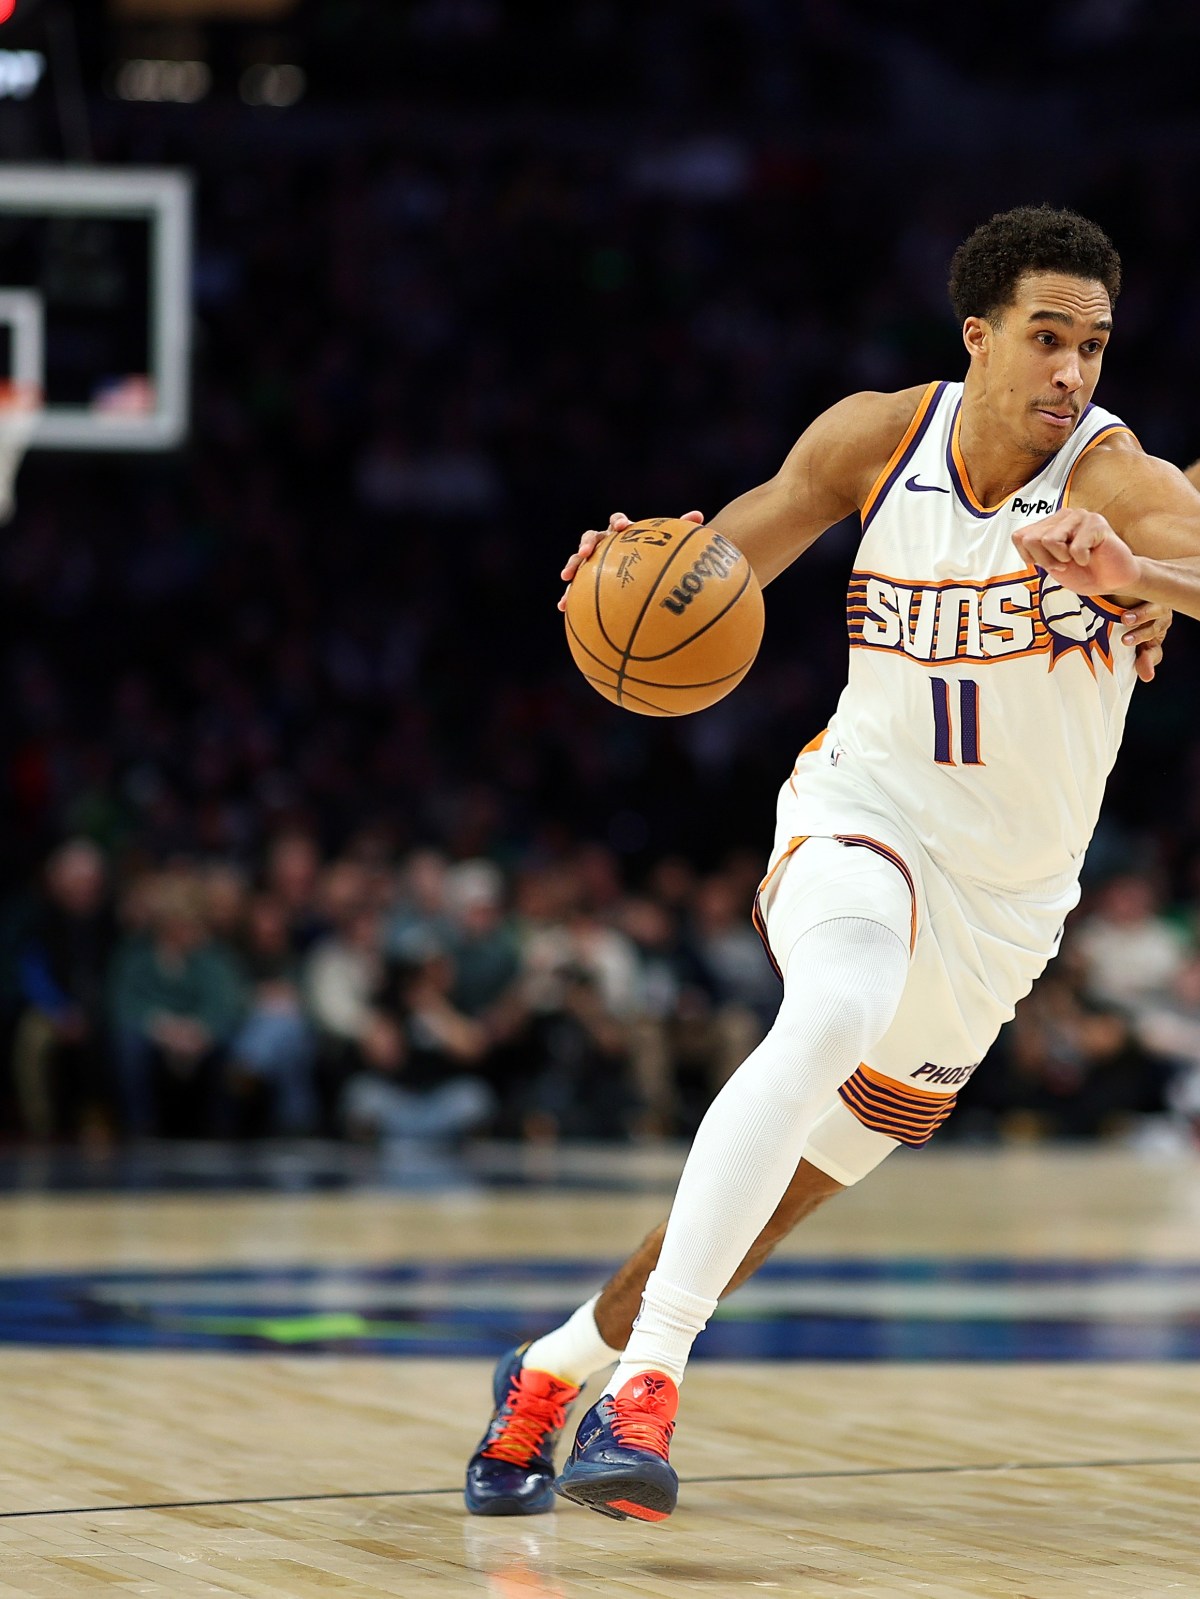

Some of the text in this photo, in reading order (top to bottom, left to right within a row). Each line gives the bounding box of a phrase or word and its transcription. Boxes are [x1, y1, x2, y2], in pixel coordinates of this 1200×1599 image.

[861, 577, 1035, 660] SUNS
[929, 676, 986, 767] 11
[909, 1061, 979, 1085] PHOE
